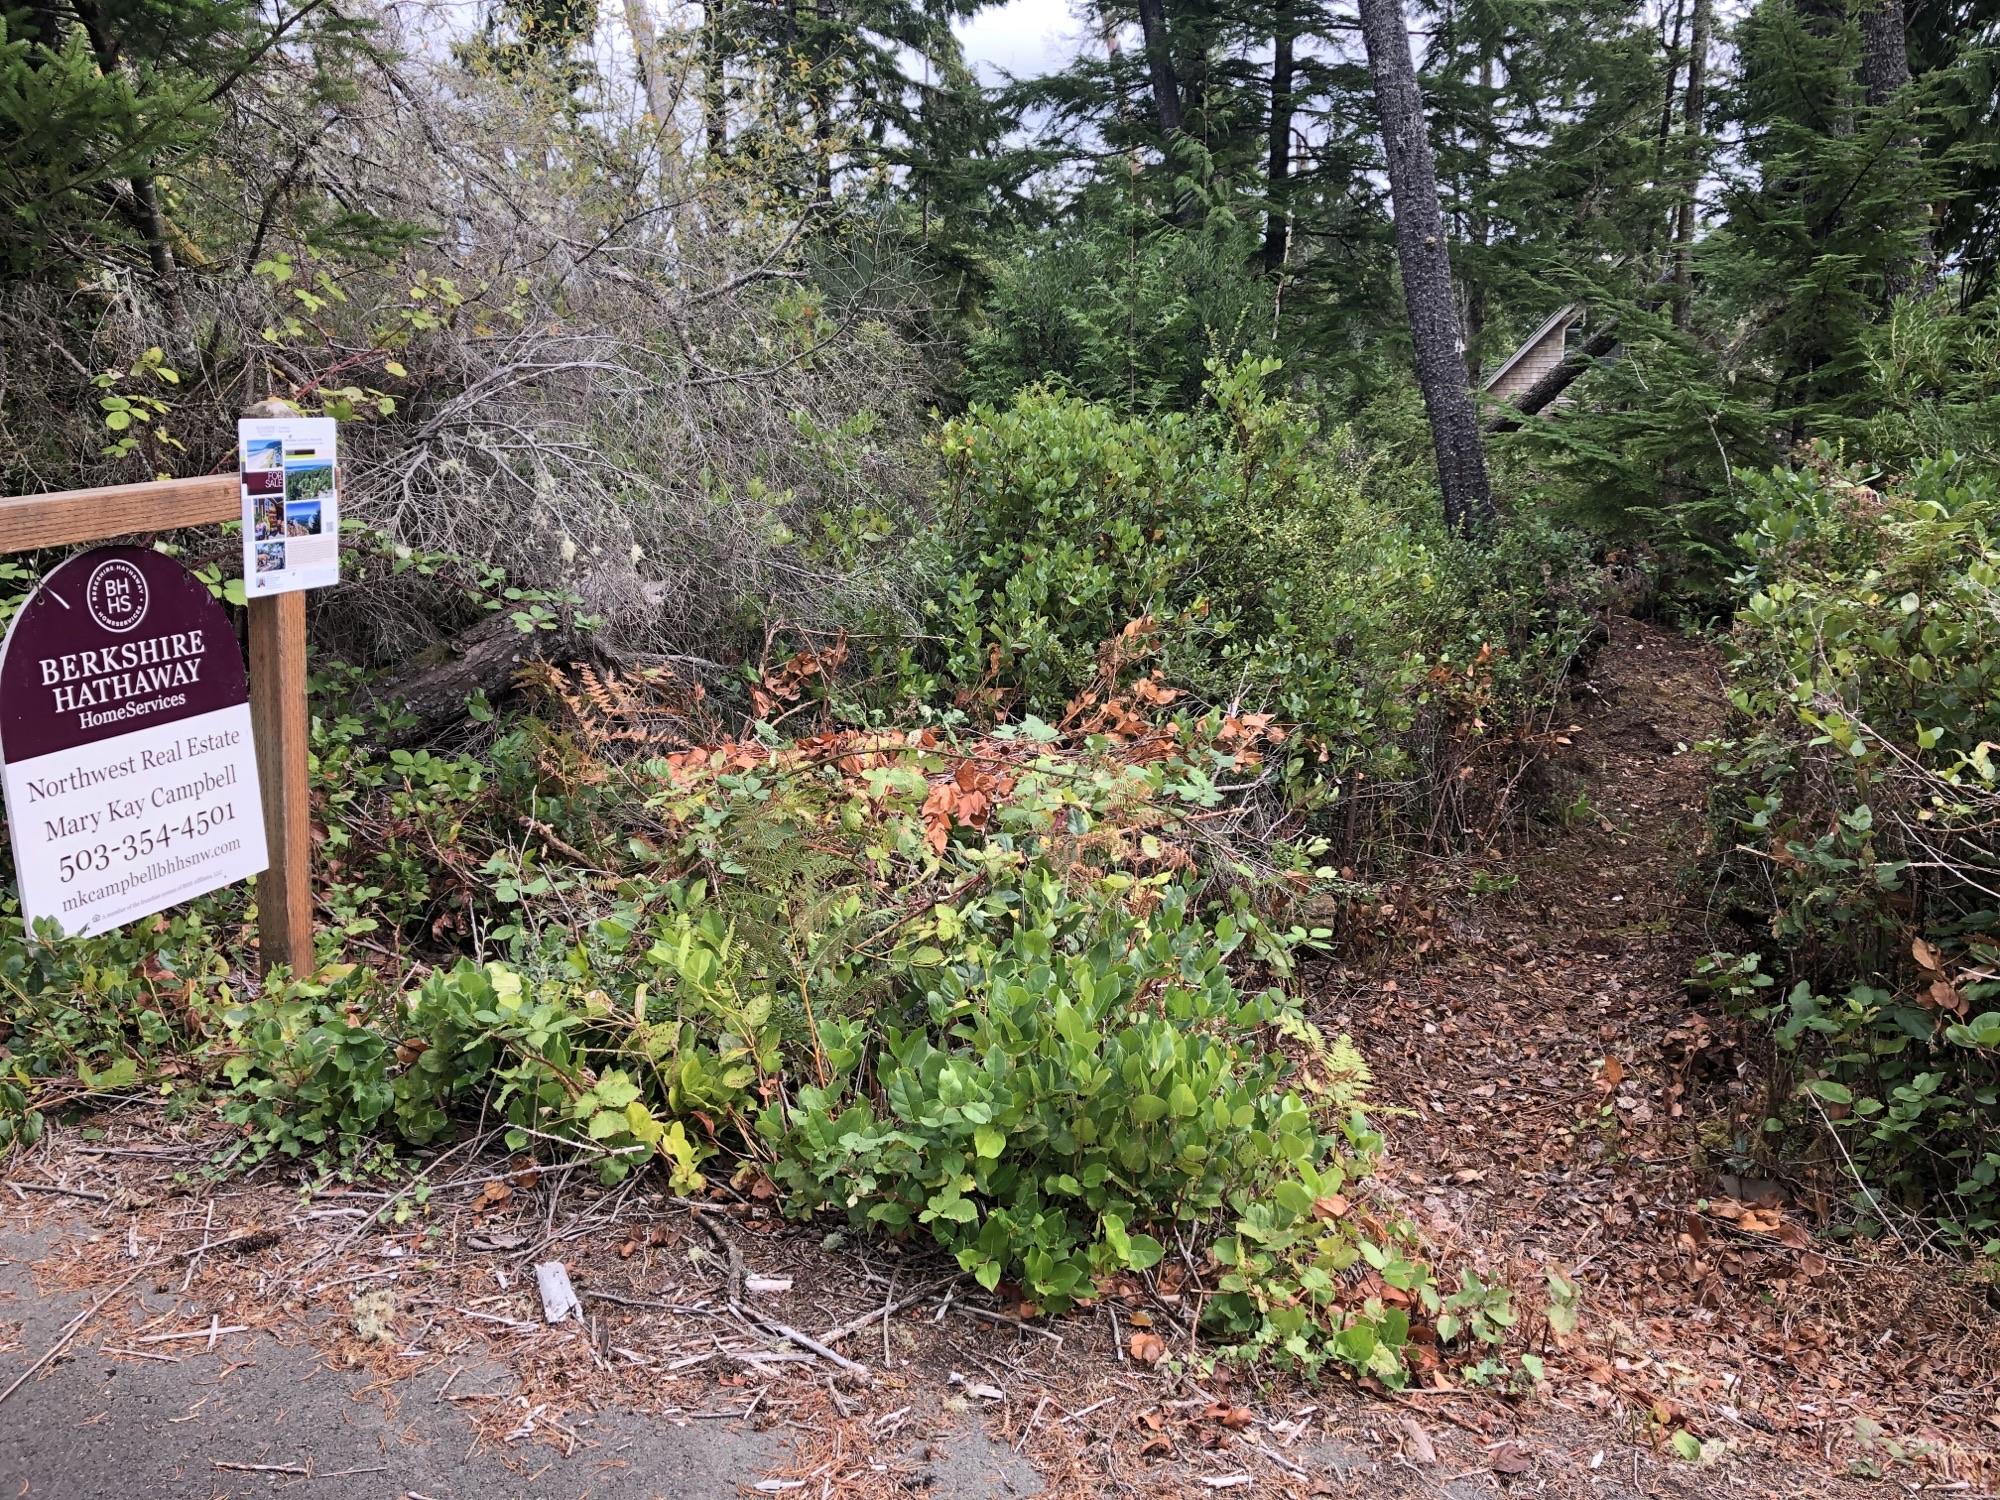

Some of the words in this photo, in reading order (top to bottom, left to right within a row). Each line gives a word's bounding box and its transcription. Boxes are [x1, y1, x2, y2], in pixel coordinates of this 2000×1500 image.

[265, 479, 283, 488] SALE
[267, 471, 282, 480] FOR
[91, 565, 114, 601] BERKSHIRE
[117, 565, 144, 594] HATHAWAY
[105, 577, 130, 597] BH
[98, 605, 142, 627] HOMESERVICES
[107, 595, 132, 614] HS
[38, 630, 206, 686] BERKSHIRE
[53, 658, 202, 713] HATHAWAY
[79, 692, 186, 729] HomeServices
[26, 756, 136, 803] Northwest
[140, 740, 182, 771] Real
[187, 729, 240, 757] Estate
[44, 810, 102, 842] Mary
[107, 797, 145, 823] Kay
[151, 763, 237, 809] Campbell
[60, 802, 235, 883] 503-354-4501
[62, 838, 241, 912] mkcampbellbhhsnw.com
